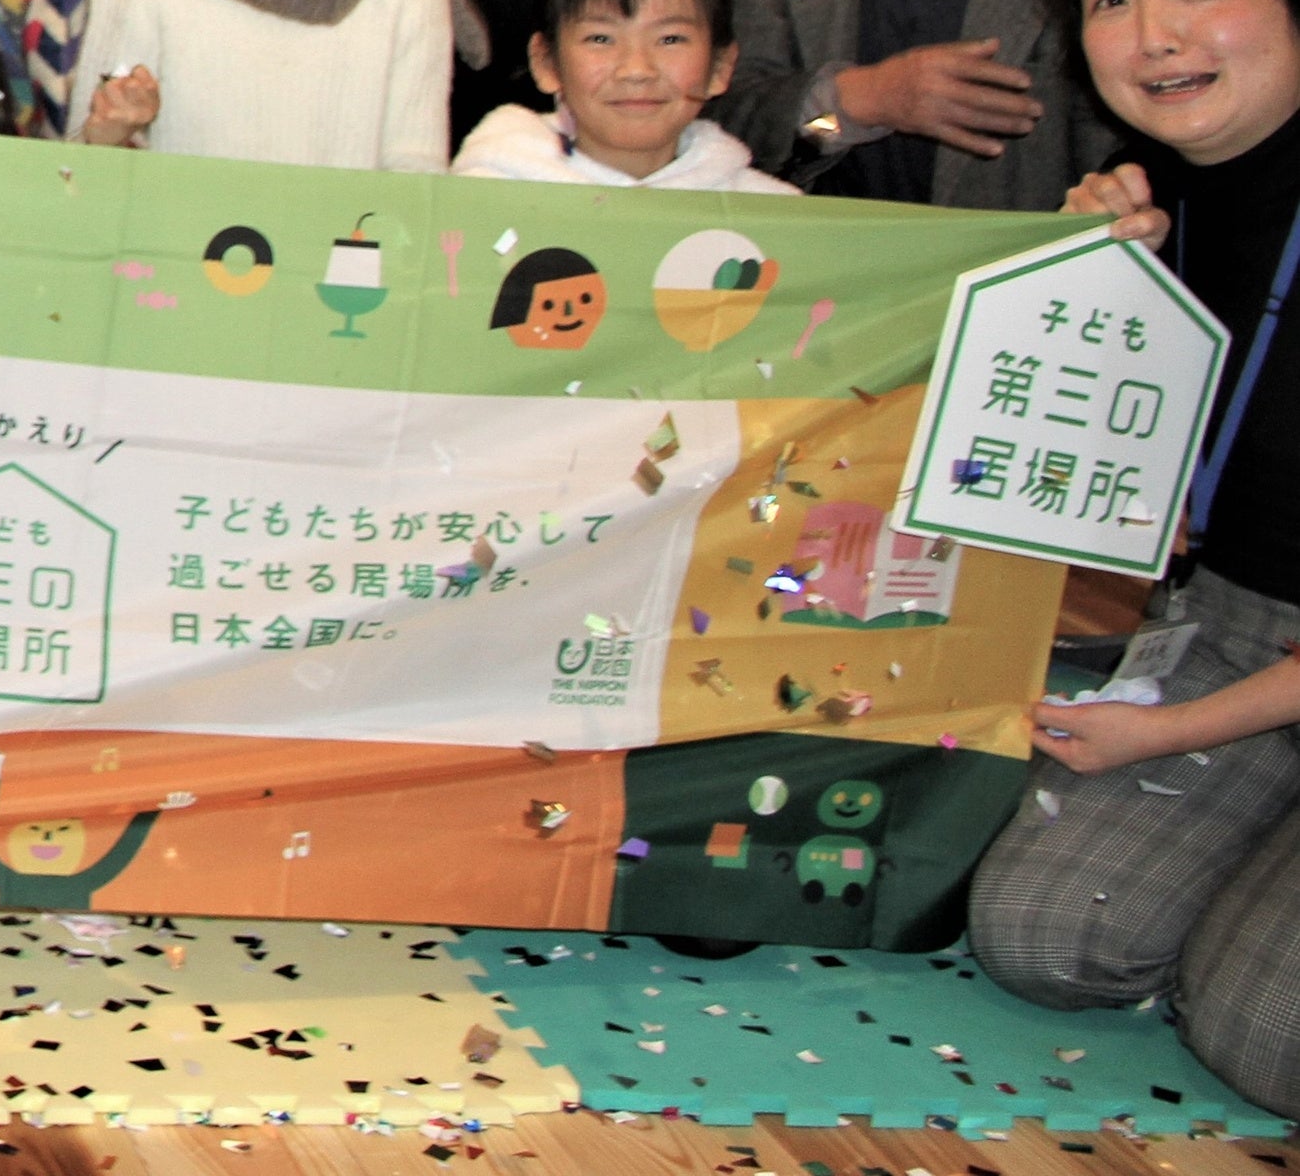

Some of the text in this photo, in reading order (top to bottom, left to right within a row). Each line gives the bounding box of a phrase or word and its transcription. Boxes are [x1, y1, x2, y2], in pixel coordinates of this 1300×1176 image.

[1041, 300, 1147, 352] 子ども
[982, 350, 1164, 440] 第三の
[952, 436, 1143, 526] 居場所
[175, 496, 614, 545] 子どもたちが安心して
[170, 611, 398, 649] 日本全国に。
